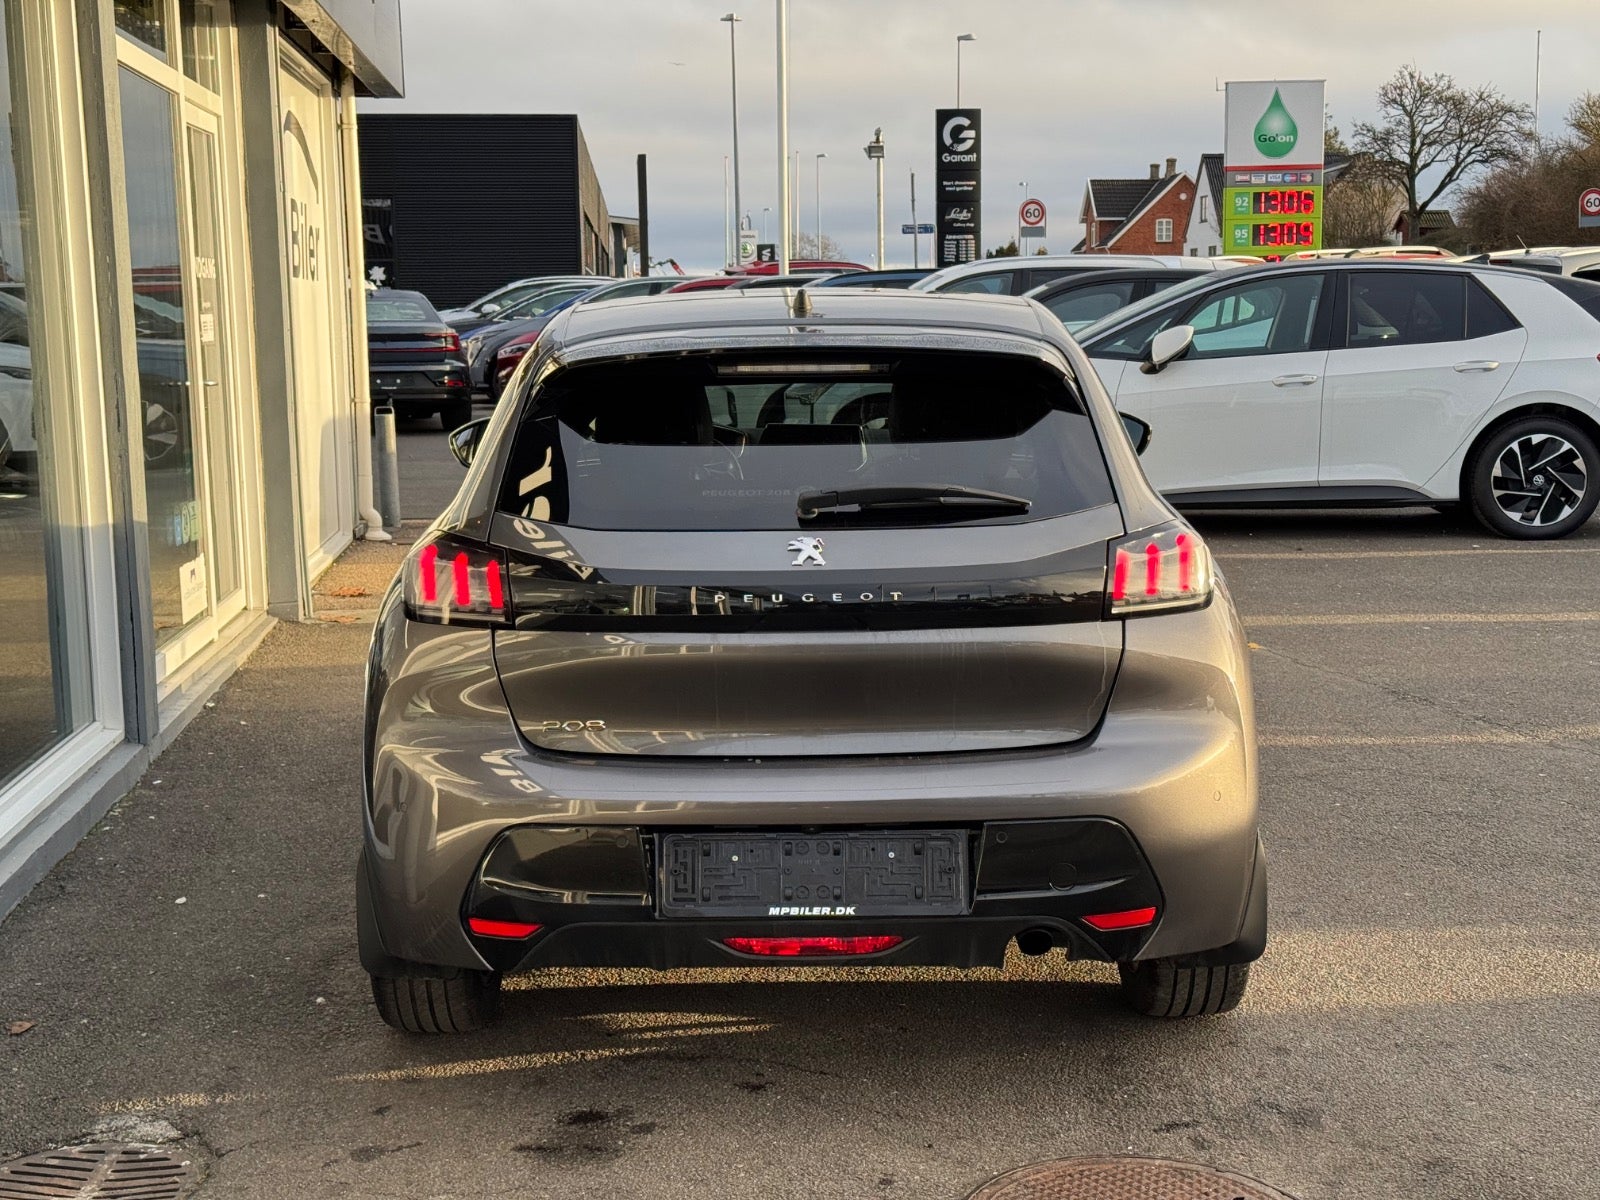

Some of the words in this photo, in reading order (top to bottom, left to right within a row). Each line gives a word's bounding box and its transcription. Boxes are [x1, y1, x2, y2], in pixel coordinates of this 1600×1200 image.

[1258, 133, 1294, 143] Go'on
[942, 153, 977, 163] Garant
[1235, 196, 1248, 206] 92
[1586, 198, 1600, 208] 60
[1025, 208, 1041, 219] 60
[1235, 228, 1248, 238] 95
[290, 197, 320, 282] Biler
[714, 592, 903, 604] PEUGEOT
[542, 720, 607, 733] 208
[768, 906, 857, 916] MPBILER.DK
